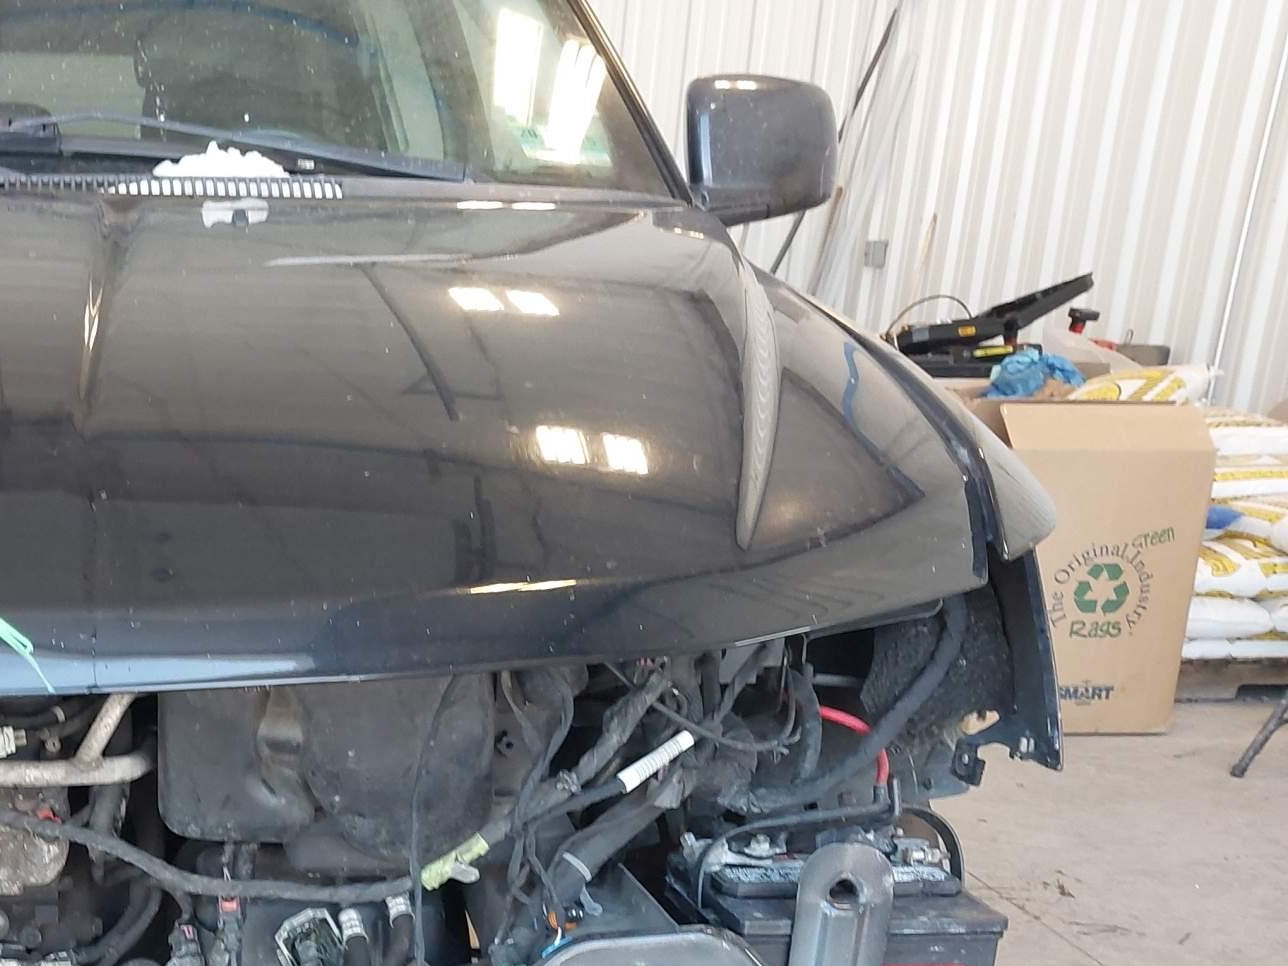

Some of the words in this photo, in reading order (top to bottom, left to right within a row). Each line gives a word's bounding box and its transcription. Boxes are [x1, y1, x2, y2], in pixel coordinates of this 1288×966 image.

[1131, 527, 1176, 550] Green
[1054, 543, 1129, 584] Original
[1048, 590, 1067, 628] The
[1126, 550, 1154, 631] Industry
[1069, 620, 1121, 640] Rags
